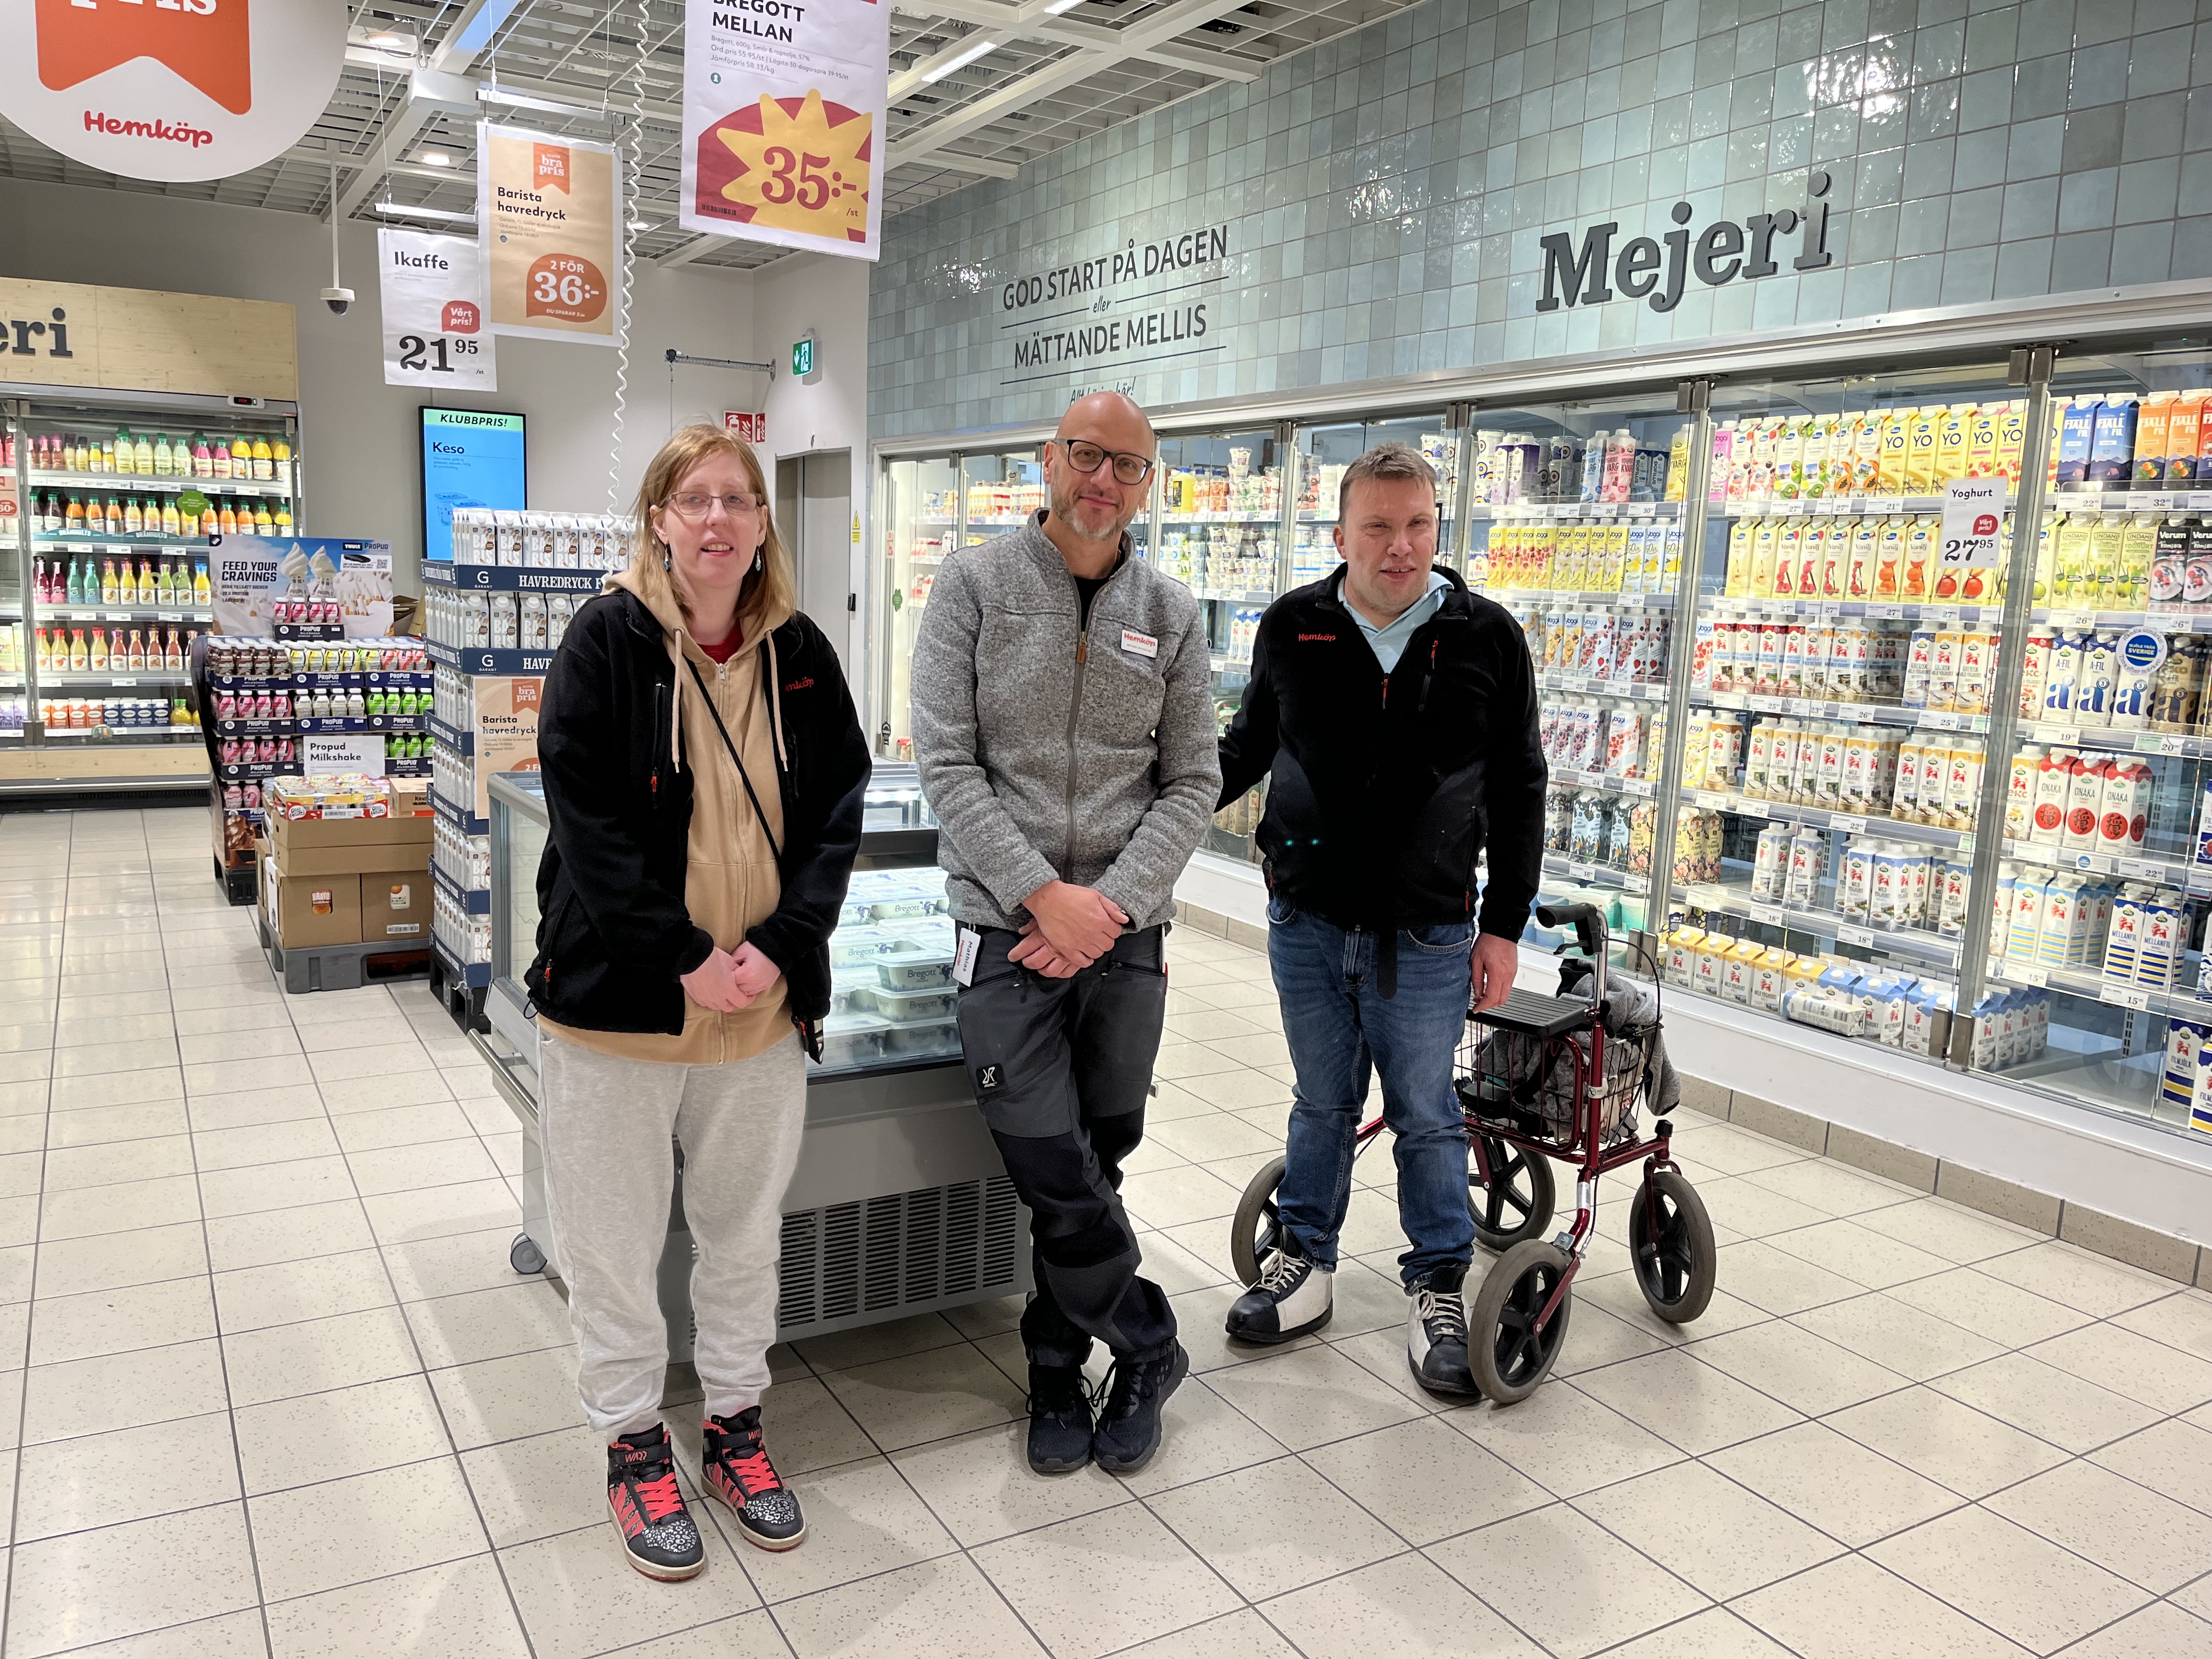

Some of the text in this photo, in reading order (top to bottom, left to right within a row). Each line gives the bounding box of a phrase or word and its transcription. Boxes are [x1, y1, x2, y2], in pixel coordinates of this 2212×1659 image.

[713, 12, 793, 43] MELLAN
[711, 35, 734, 46] Bregott,
[736, 41, 752, 50] 600g,
[753, 44, 768, 52] Smör
[774, 49, 798, 60] rapsolja,
[711, 44, 737, 55] Ord.pris
[738, 50, 764, 61] 55.95/st
[769, 57, 788, 67] Lägsta
[789, 62, 826, 75] 30-dagarspris
[711, 54, 775, 75] Jämförpris 58.33/kg
[83, 110, 213, 148] Hemköp
[541, 154, 563, 168] bra
[539, 165, 565, 176] pris
[761, 146, 857, 211] 35:-
[497, 186, 542, 203] Barista
[497, 201, 567, 221] havredryck
[846, 207, 859, 218] /st
[1536, 172, 1833, 313] Mejeri
[394, 251, 449, 270] Ikaffe
[550, 260, 585, 273] 2 FÖR
[1003, 225, 1228, 311] GOD START PÅ DAGEN
[534, 271, 600, 306] 36:-
[1093, 295, 1111, 314] eller
[450, 307, 473, 317] Vårt
[450, 317, 473, 326] pris!
[1014, 304, 1207, 369] MÄTTANDE MELLIS
[440, 414, 508, 427] KLUBBPRIS!
[432, 442, 465, 454] Keso
[1952, 488, 1993, 500] Yoghurt
[2159, 531, 2187, 539] Verum
[223, 561, 278, 571] FEED YOUR
[222, 571, 278, 582] CRAVINGS
[518, 575, 592, 590] HAVREDRYCK
[1124, 632, 1156, 647] Hemköp
[1299, 633, 1336, 642] Hemköp
[2122, 628, 2141, 641] Handla
[516, 693, 537, 702] pris
[483, 726, 537, 736] havredryck
[310, 742, 346, 753] Propud
[310, 753, 362, 762] Milkshake
[2042, 783, 2062, 794] ONAKA
[2074, 787, 2095, 798] ONAKA
[2107, 792, 2128, 803] ONAKA
[895, 904, 919, 915] Bregott
[2112, 930, 2137, 941] MELLANFIL
[2144, 936, 2171, 948] MELLANFIL
[848, 947, 874, 958] Bregott
[907, 968, 936, 979] Bregott
[910, 1000, 938, 1012] Bregott
